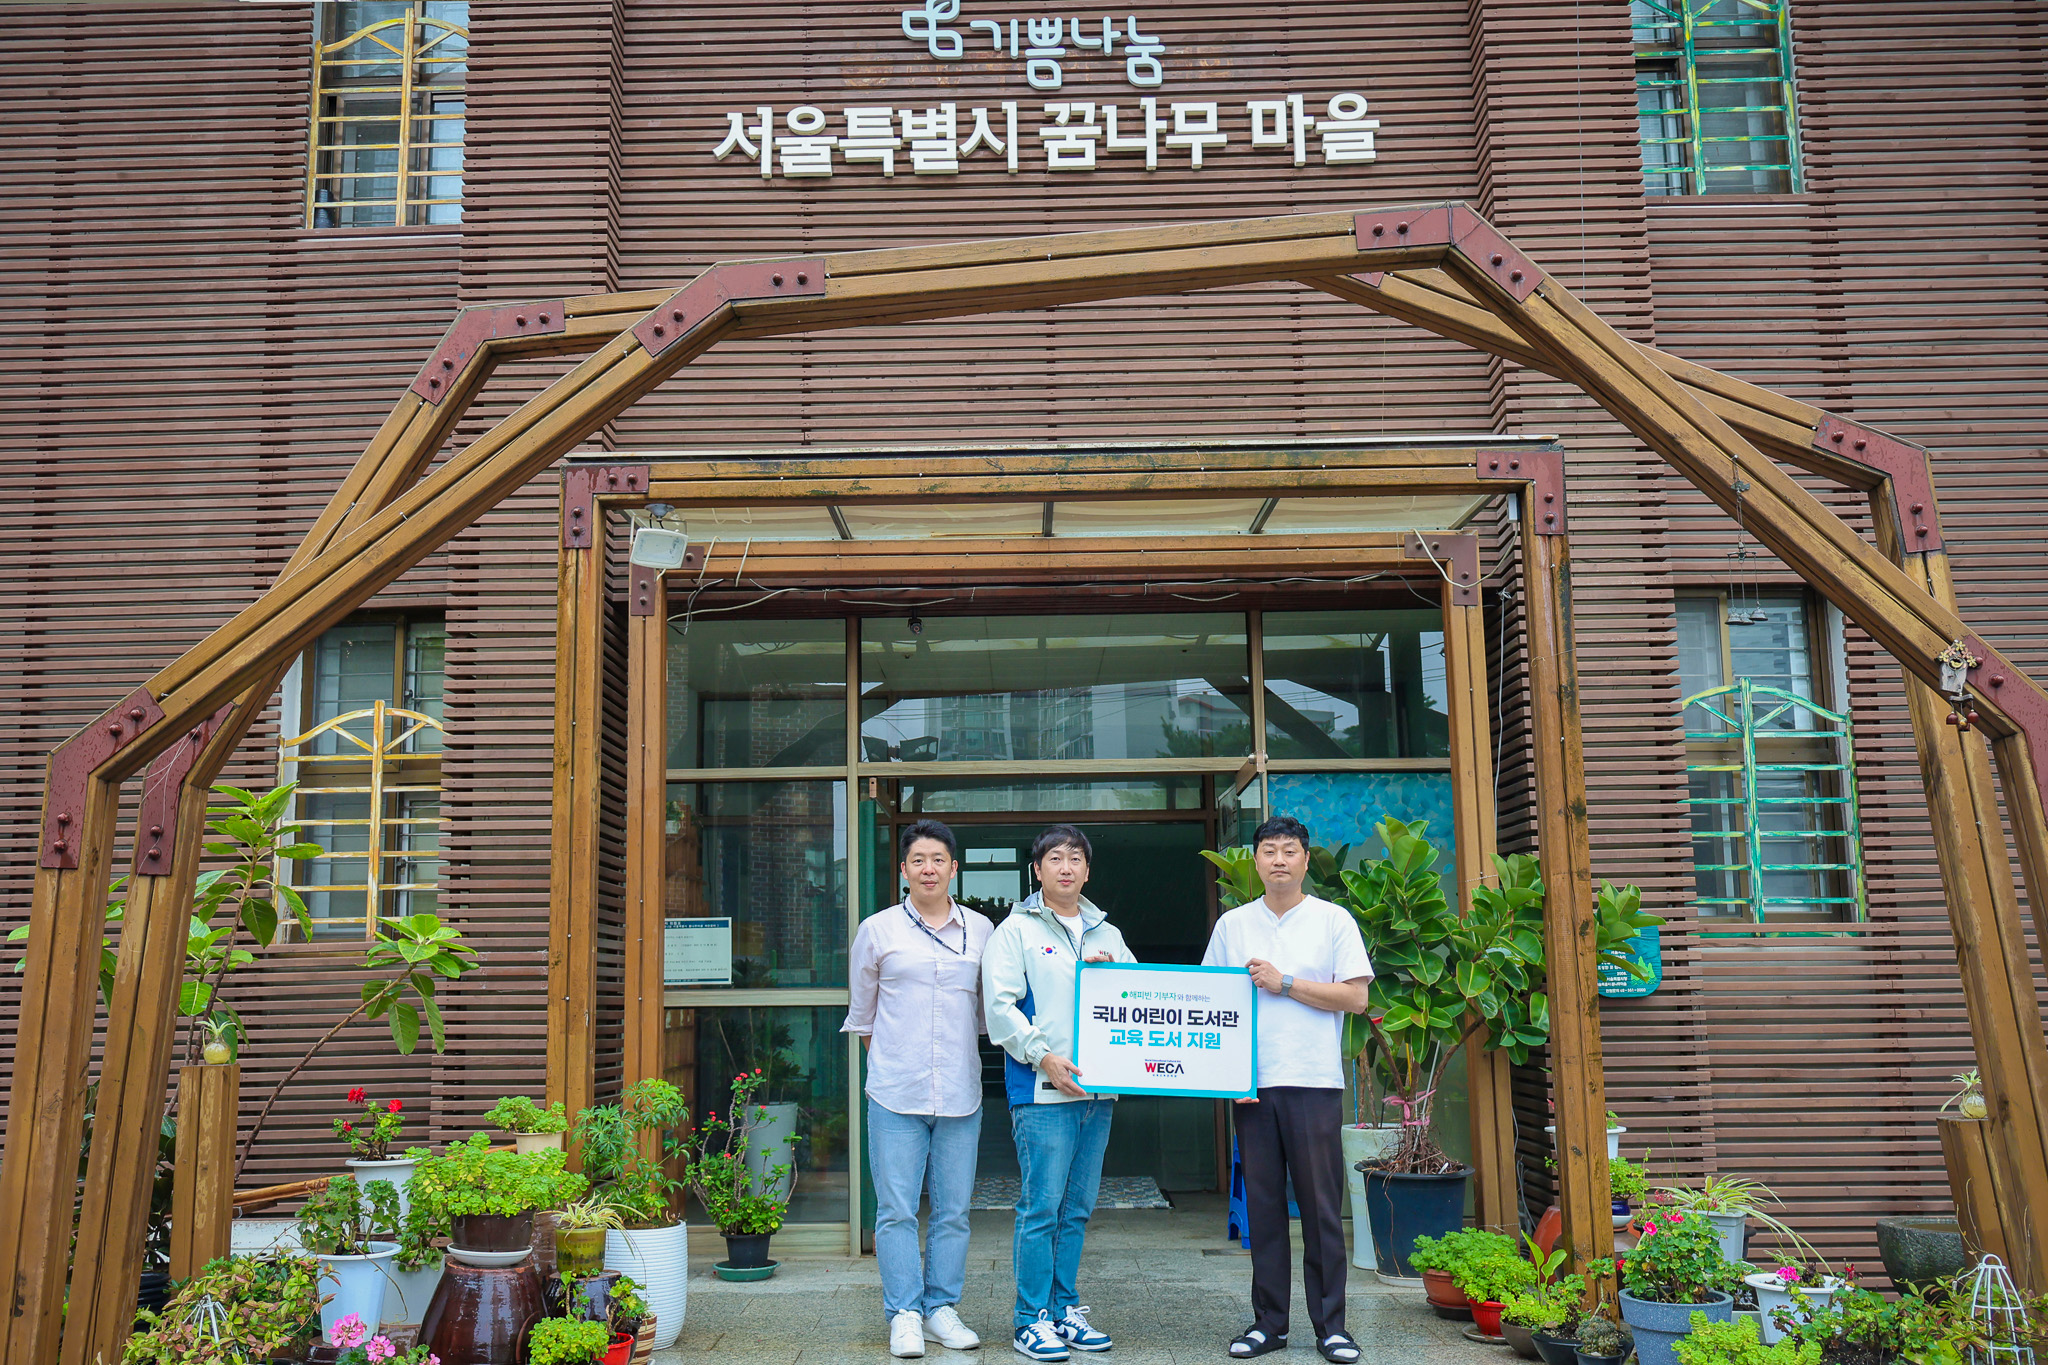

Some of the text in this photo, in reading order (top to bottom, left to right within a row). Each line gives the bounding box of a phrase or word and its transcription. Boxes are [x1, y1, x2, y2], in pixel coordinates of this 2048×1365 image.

[970, 15, 1165, 90] 기쁨나눔
[713, 93, 1380, 180] 서울특별시 꿈나무 마을
[1129, 990, 1152, 1000] 해피빈
[1092, 1005, 1239, 1028] 국내 어린이 도서관
[1109, 1028, 1221, 1050] 교육 도서 지원
[1144, 1062, 1185, 1075] WECA
